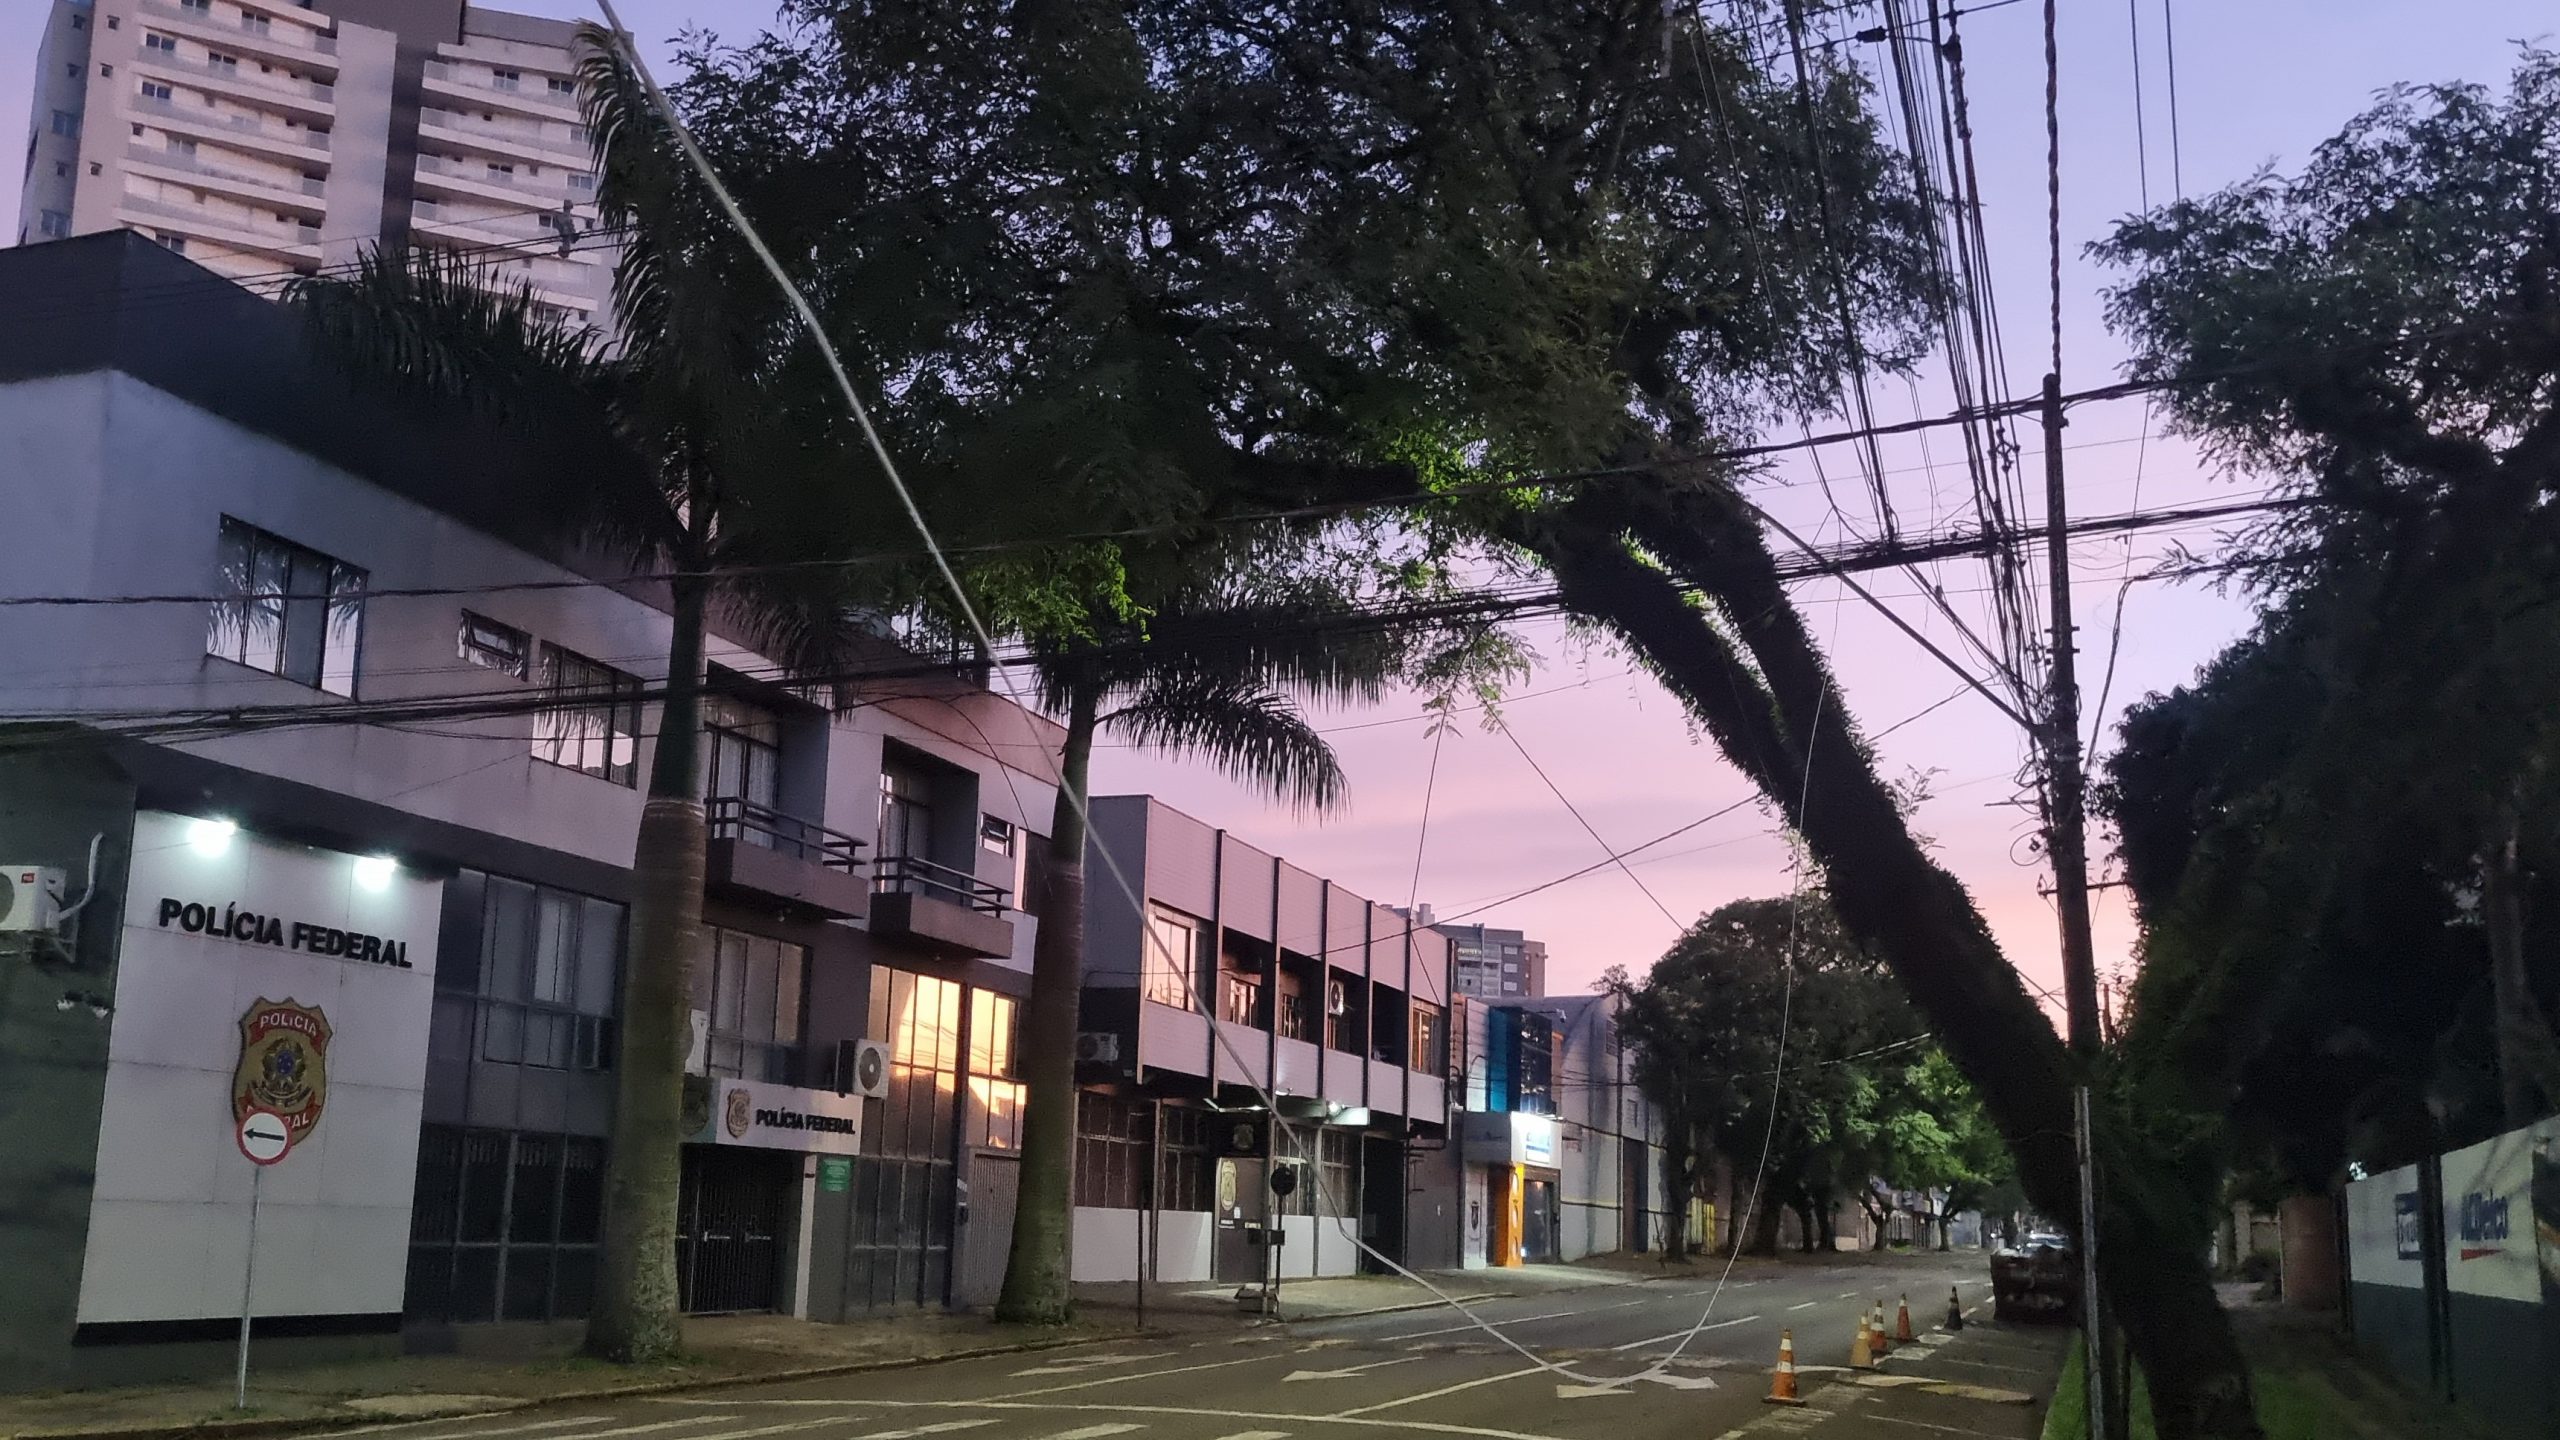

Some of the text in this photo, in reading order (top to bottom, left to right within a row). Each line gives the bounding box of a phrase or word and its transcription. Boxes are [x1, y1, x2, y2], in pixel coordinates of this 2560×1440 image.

[159, 897, 413, 968] POLÍCIA FEDERAL
[756, 1107, 856, 1135] POLÍCIA FEDERAL
